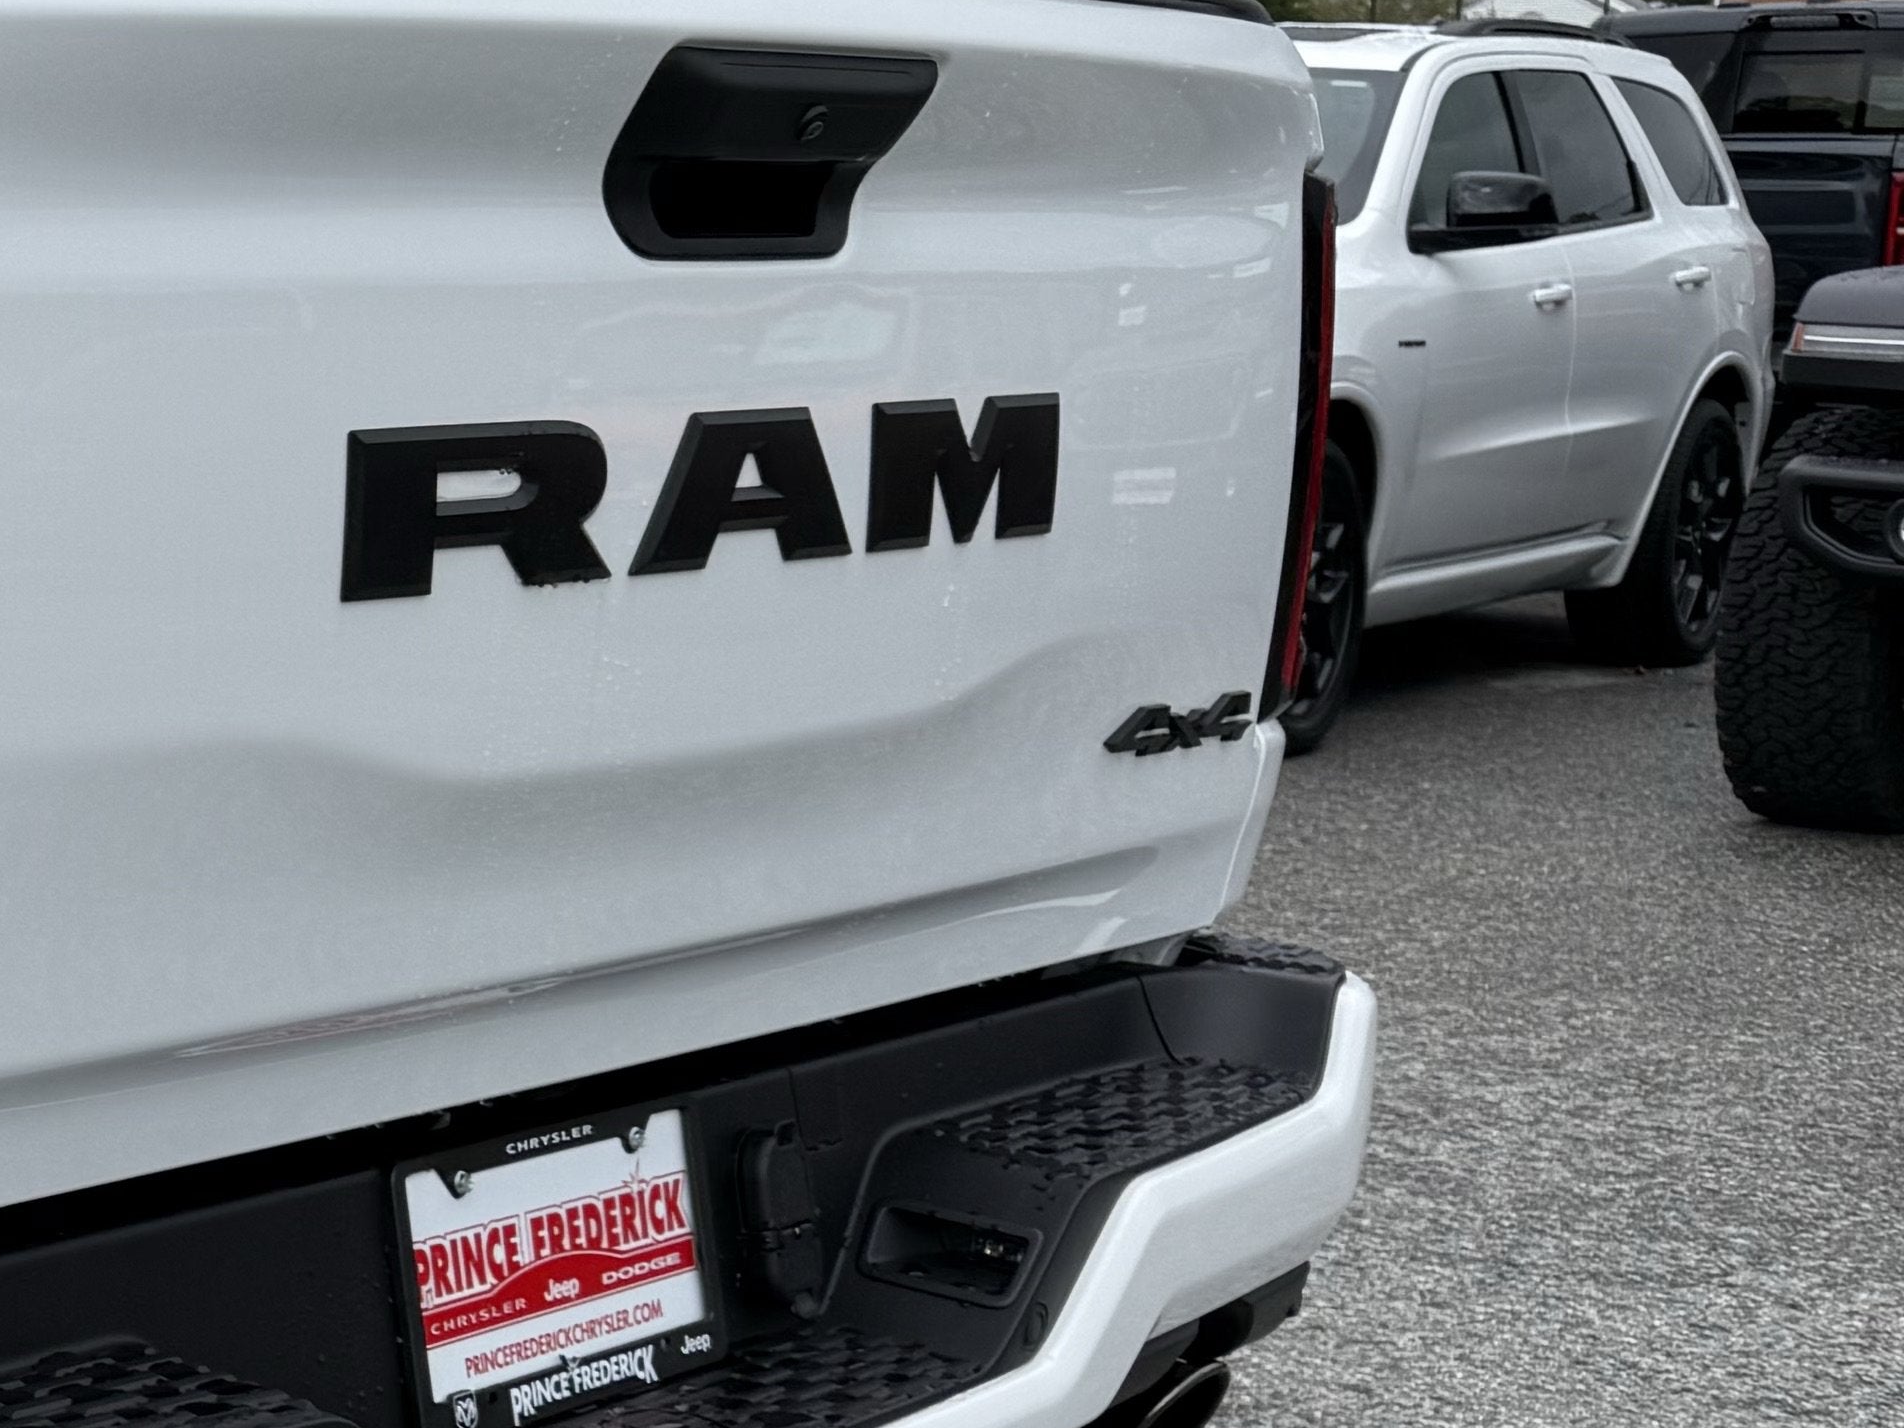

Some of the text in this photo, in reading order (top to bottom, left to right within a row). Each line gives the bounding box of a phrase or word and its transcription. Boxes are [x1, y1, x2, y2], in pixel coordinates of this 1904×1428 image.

[338, 391, 1062, 604] RAM
[505, 1123, 594, 1155] CHRYSLER
[413, 1177, 688, 1302] PRINCE FREDERICK
[430, 1250, 682, 1336] CHRYSLER Jeep DODGE
[464, 1298, 664, 1379] PRINCEFREDERICKCHRYSLER.COM
[679, 1333, 712, 1356] Jeep
[509, 1344, 660, 1428] PRINCE FREDERICK
